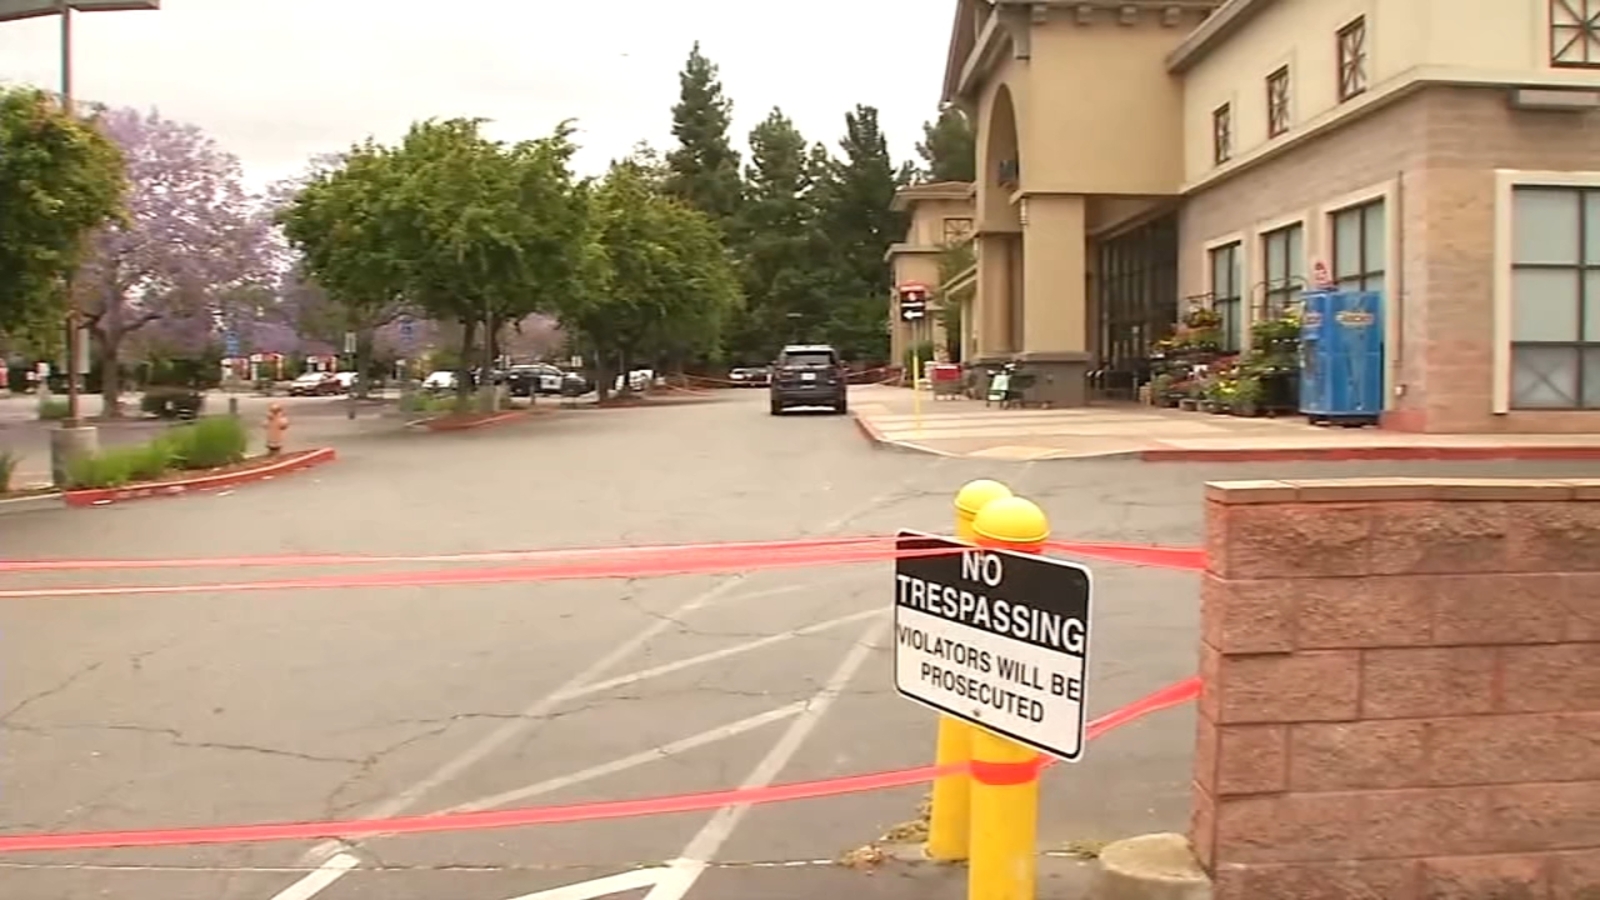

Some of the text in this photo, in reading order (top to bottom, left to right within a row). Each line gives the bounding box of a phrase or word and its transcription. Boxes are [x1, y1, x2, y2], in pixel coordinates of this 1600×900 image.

[961, 550, 1003, 587] NO
[897, 574, 1085, 653] TRESPASSING
[898, 624, 1080, 702] VIOLATORS WILL BE
[921, 662, 1044, 723] PROSECUTED
